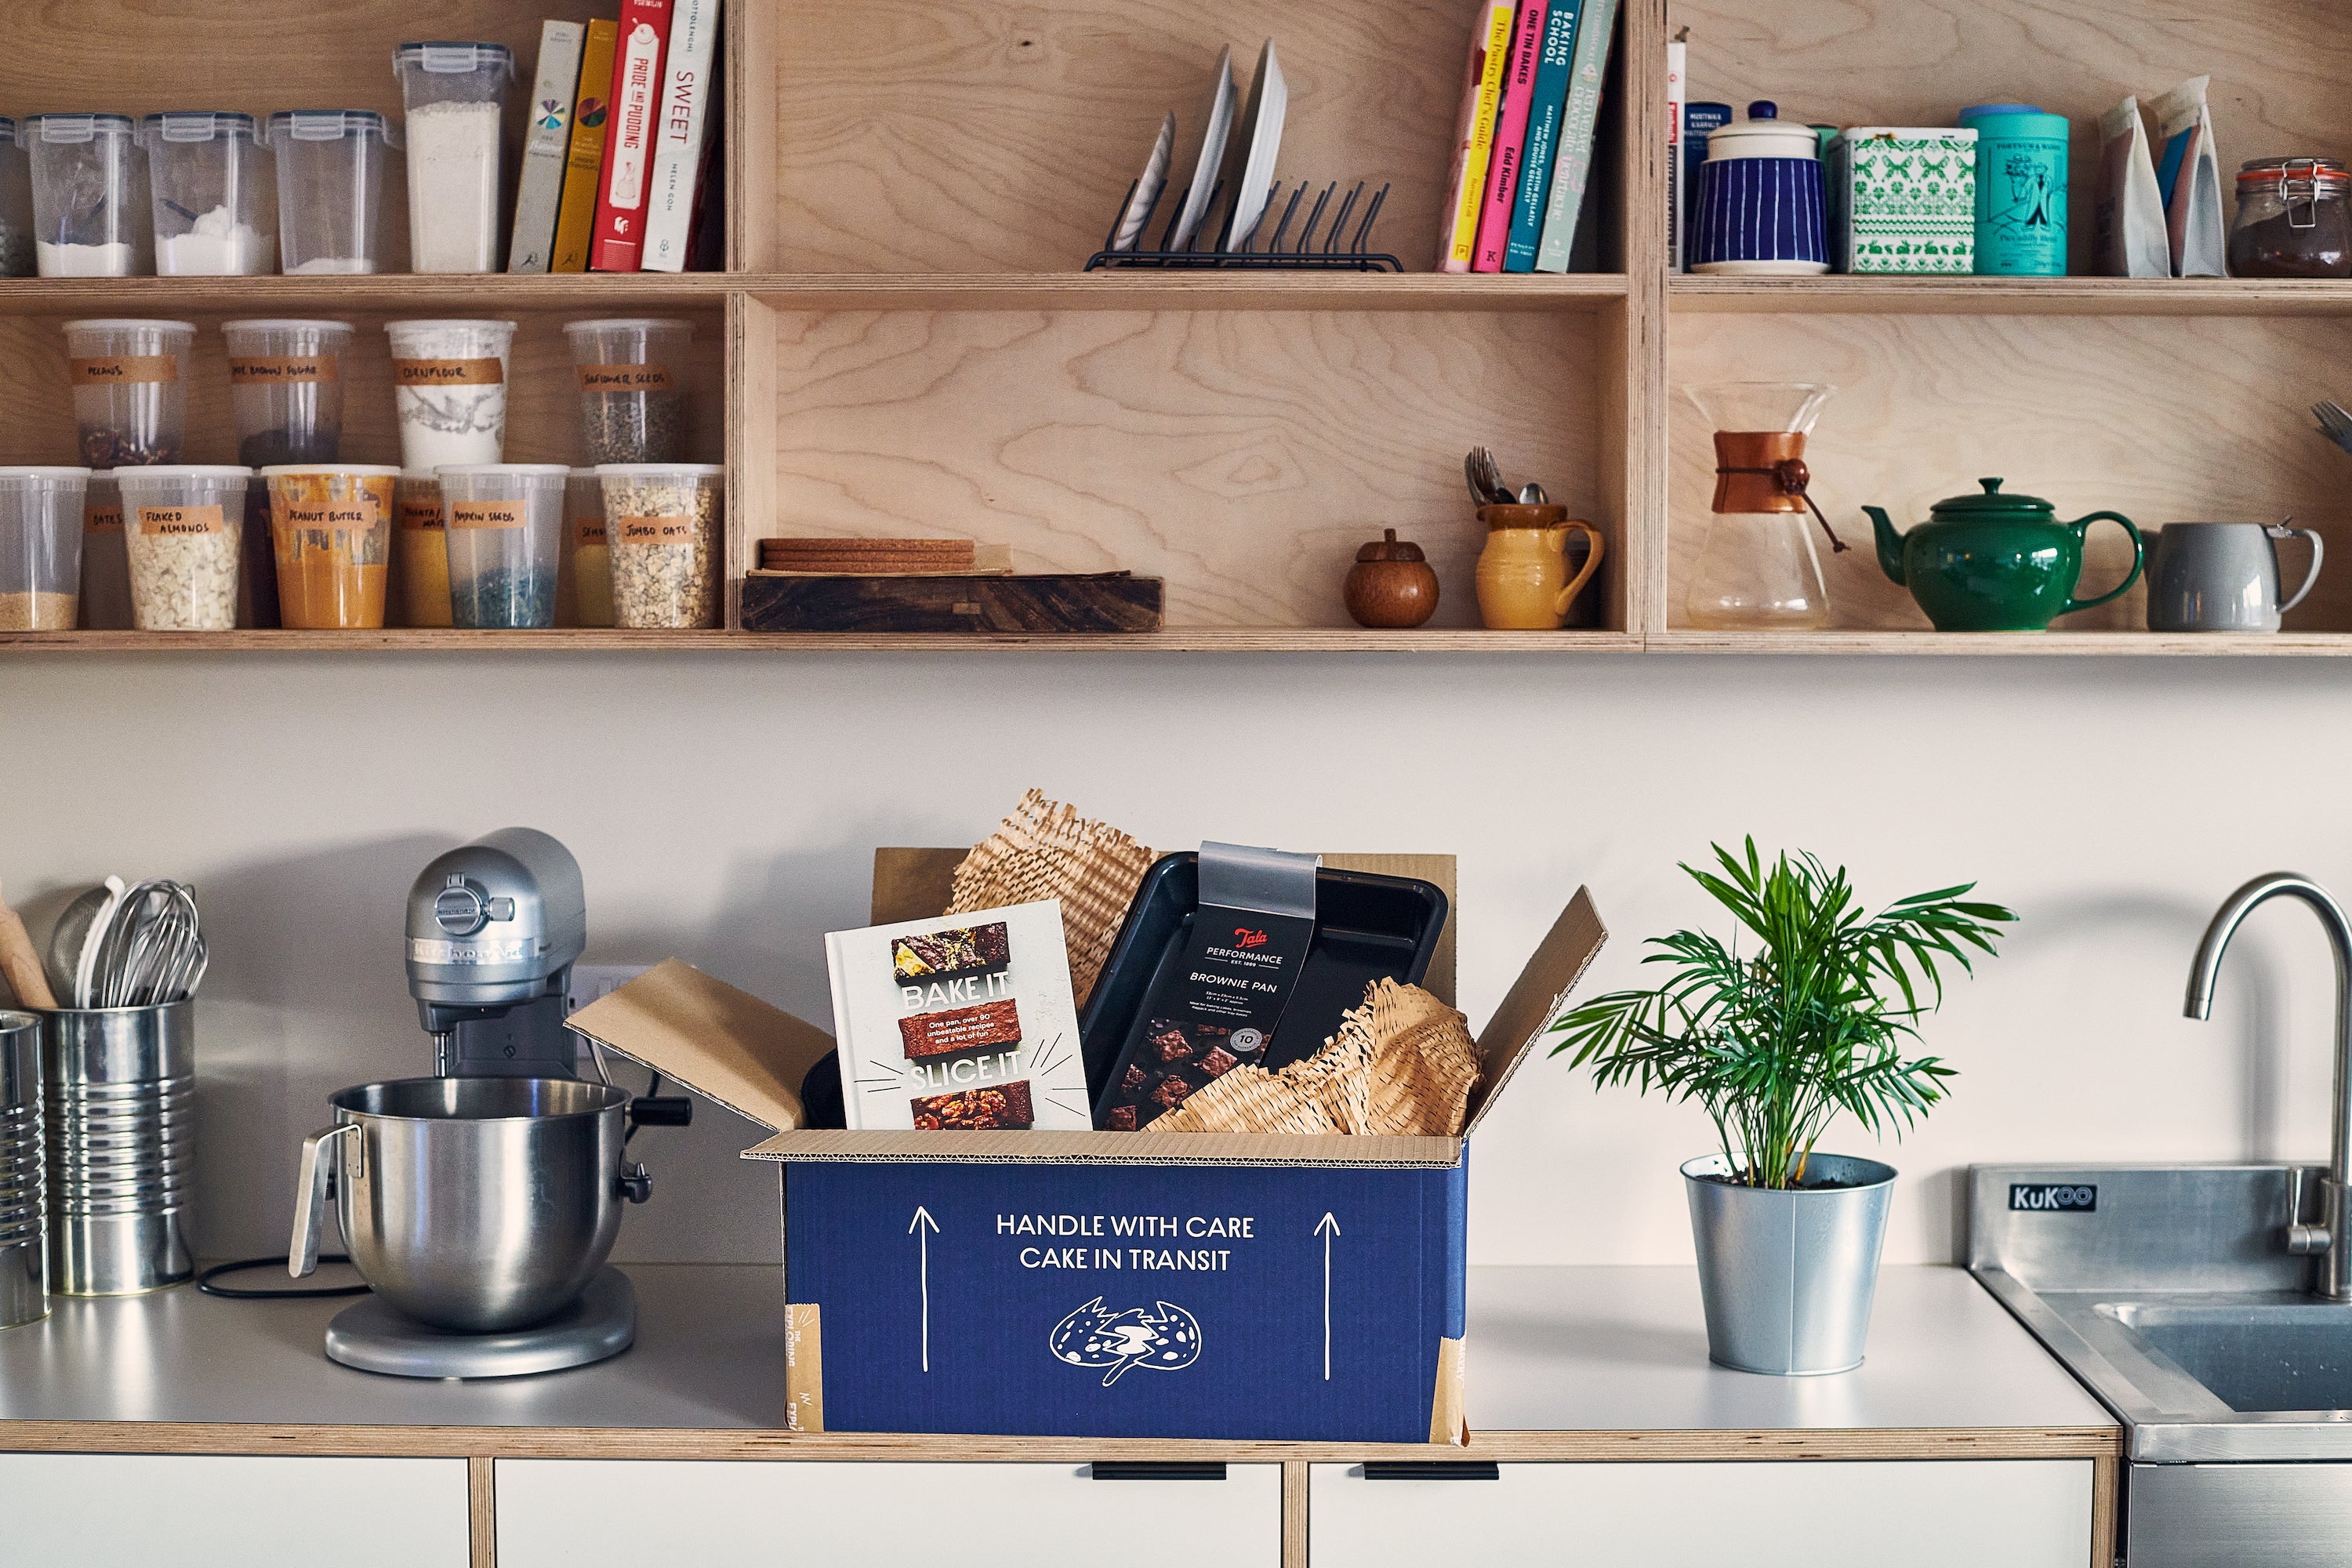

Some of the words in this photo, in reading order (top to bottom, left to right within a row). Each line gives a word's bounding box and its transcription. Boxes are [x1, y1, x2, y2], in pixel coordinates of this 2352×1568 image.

[1494, 22, 1505, 41] The
[1526, 9, 1539, 31] ONE
[1523, 32, 1535, 49] TIN
[1544, 9, 1563, 64] SCHOOL
[1555, 12, 1574, 66] BAKING
[1488, 43, 1503, 76] Pastry
[1517, 50, 1532, 85] BAKES
[630, 58, 649, 89] PRIDE
[670, 71, 695, 144] SWEET
[1483, 81, 1496, 114] Chef's
[624, 103, 644, 150] PUDDING
[1476, 117, 1489, 150] Guide
[1543, 104, 1553, 140] MATTHEW
[1503, 146, 1515, 167] Edd
[670, 163, 678, 190] HELEN
[1497, 167, 1512, 203] Kimber
[1533, 167, 1543, 191] JUSTIN
[93, 513, 123, 525] DATES
[146, 511, 183, 521] FLAKED
[289, 510, 324, 521] PEANUT
[328, 510, 364, 521] BUTTER
[160, 522, 210, 534] ALMONDS
[626, 523, 656, 537] JUMBO
[662, 525, 688, 536] OATS
[1234, 927, 1268, 948] Tala
[1206, 946, 1283, 965] PERFORMANCE
[901, 976, 981, 1011] BAKE
[985, 971, 1009, 997] IT
[1189, 971, 1250, 989] BROWNIE
[1251, 982, 1278, 993] PAN
[927, 1026, 967, 1038] unbeatable
[968, 1022, 995, 1032] recipes
[935, 1036, 949, 1044] and
[956, 1033, 967, 1041] lot
[976, 1030, 989, 1039] fun
[1240, 1035, 1254, 1044] 10
[909, 1055, 993, 1091] SLICE
[997, 1051, 1022, 1077] IT
[996, 1214, 1105, 1237] HANDLE
[1110, 1215, 1178, 1237] WITH
[1185, 1216, 1254, 1239] CARE
[1019, 1247, 1088, 1269] CAKE
[1094, 1249, 1122, 1270] IN
[1128, 1249, 1231, 1271] TRANSIT
